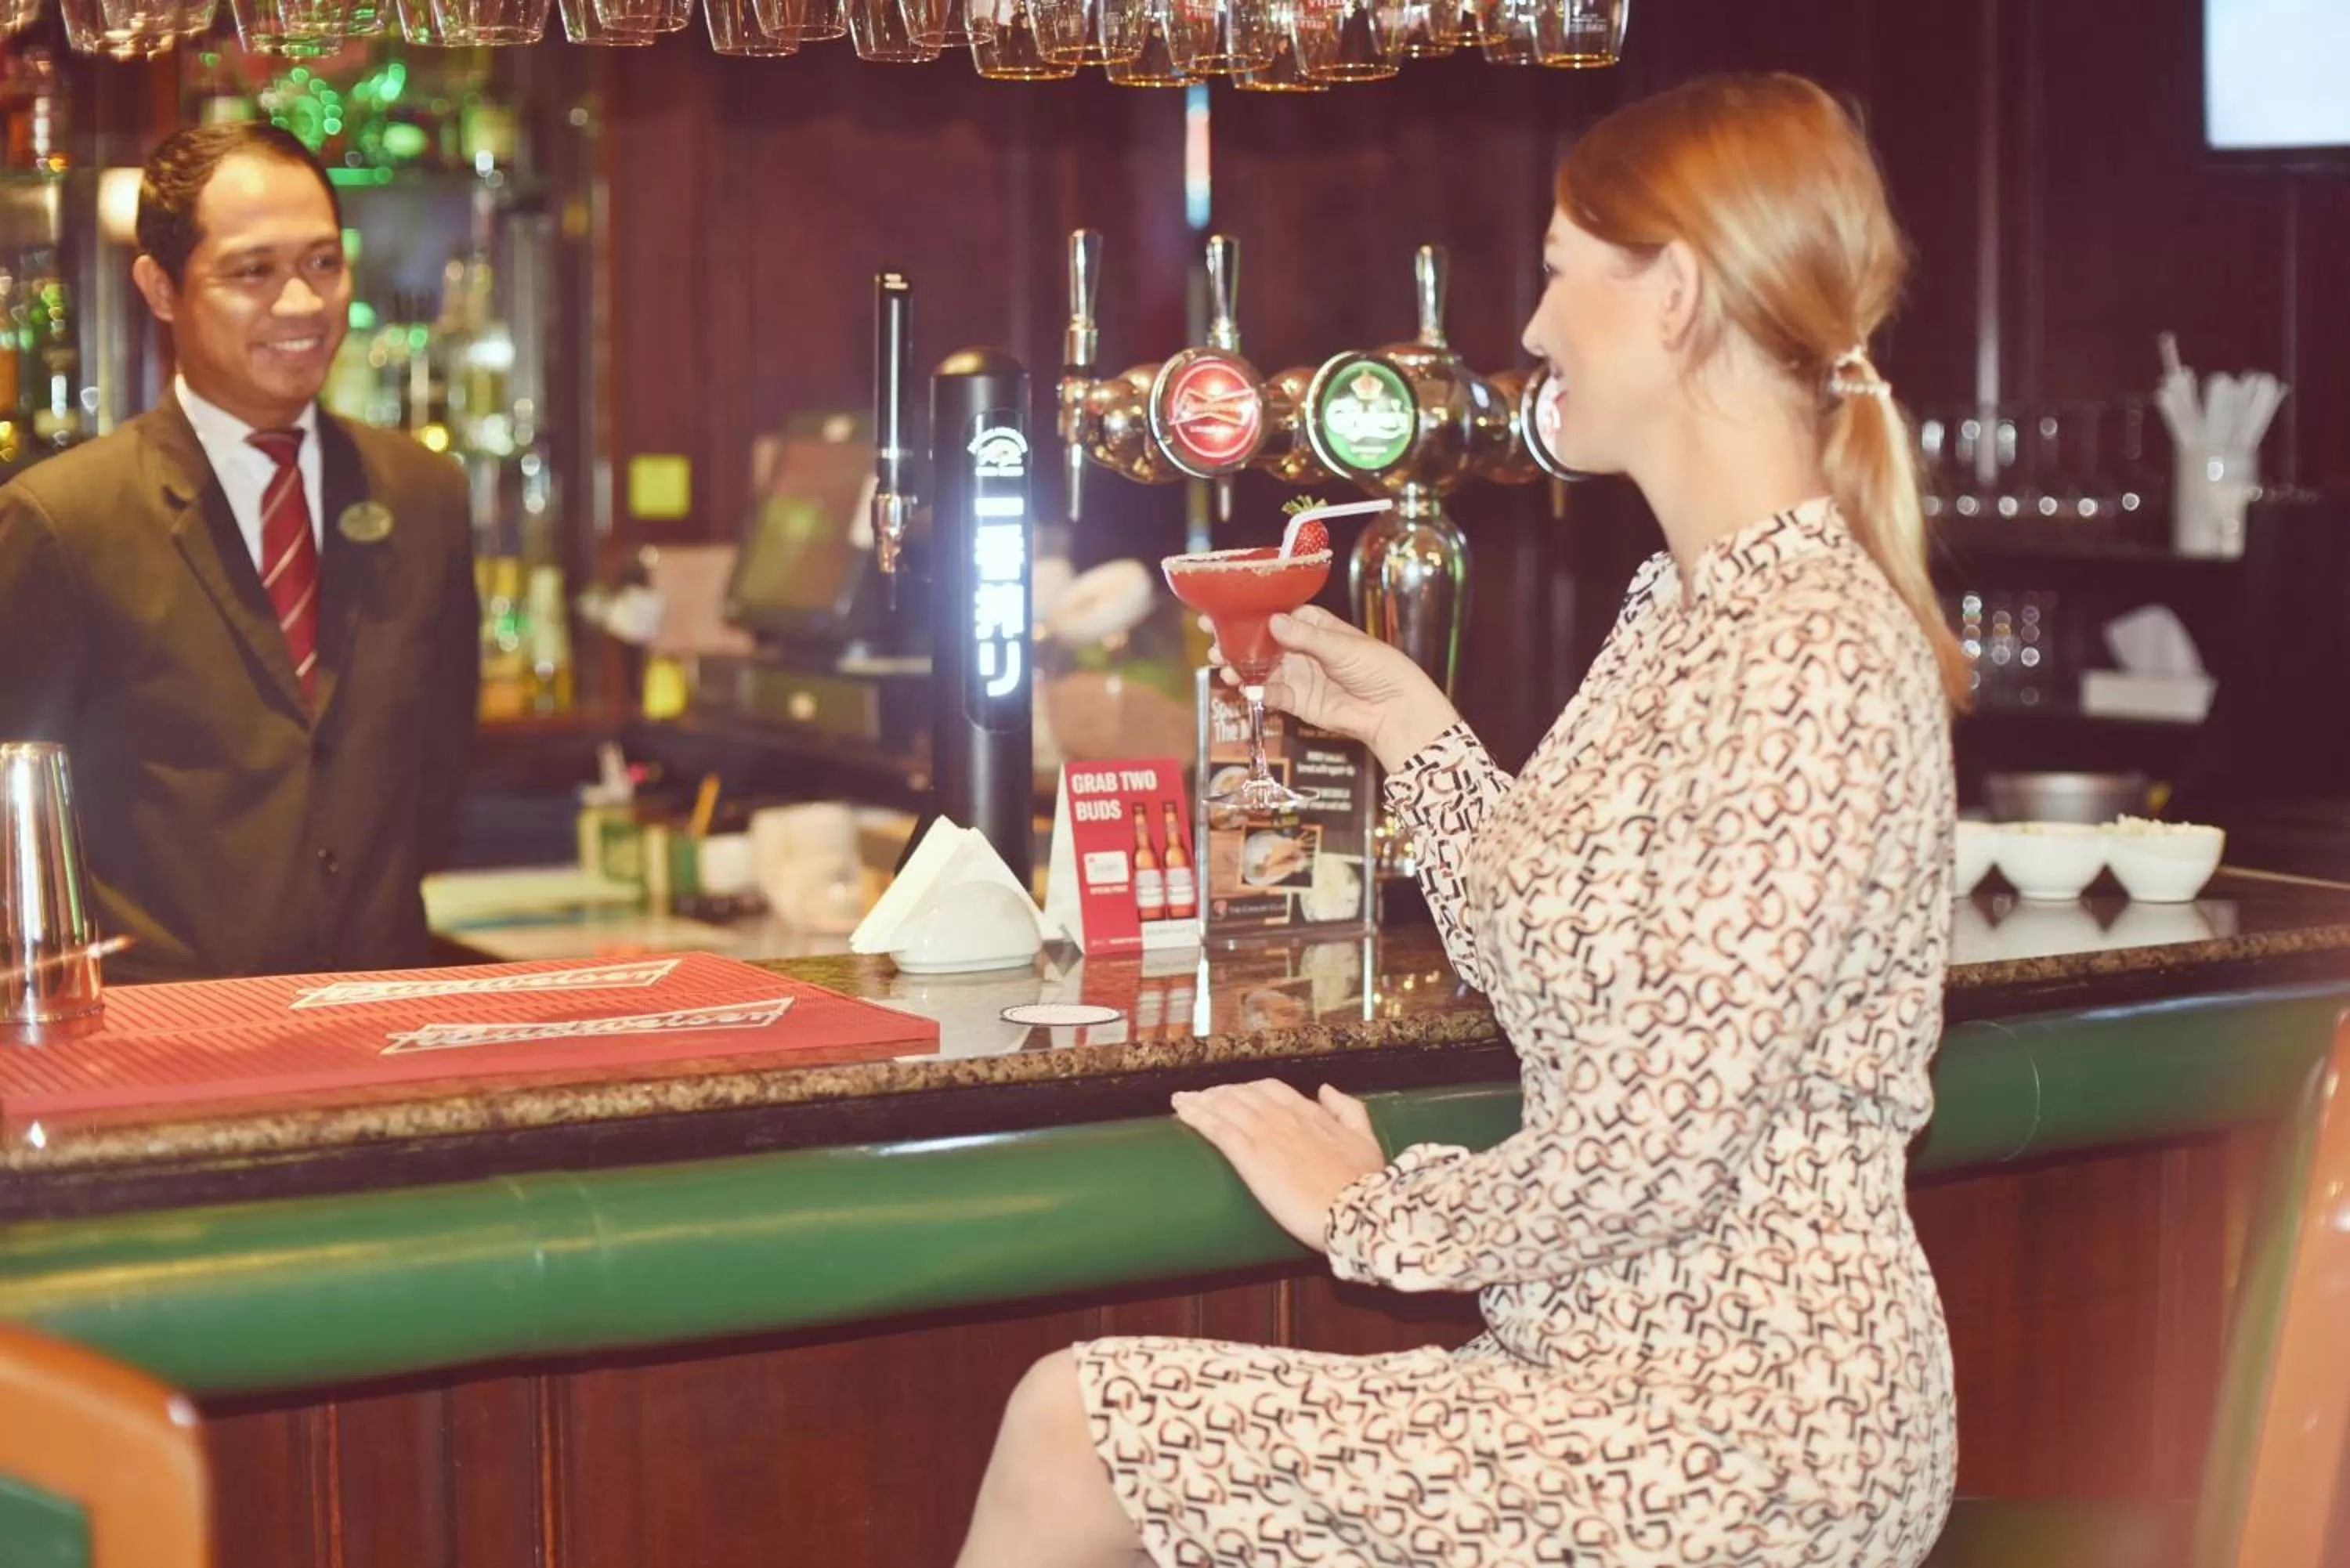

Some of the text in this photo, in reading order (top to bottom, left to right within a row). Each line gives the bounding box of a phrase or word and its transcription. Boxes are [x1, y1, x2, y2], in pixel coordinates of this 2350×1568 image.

[1072, 768, 1158, 794] GRAB TWO
[1075, 798, 1123, 822] BUDS
